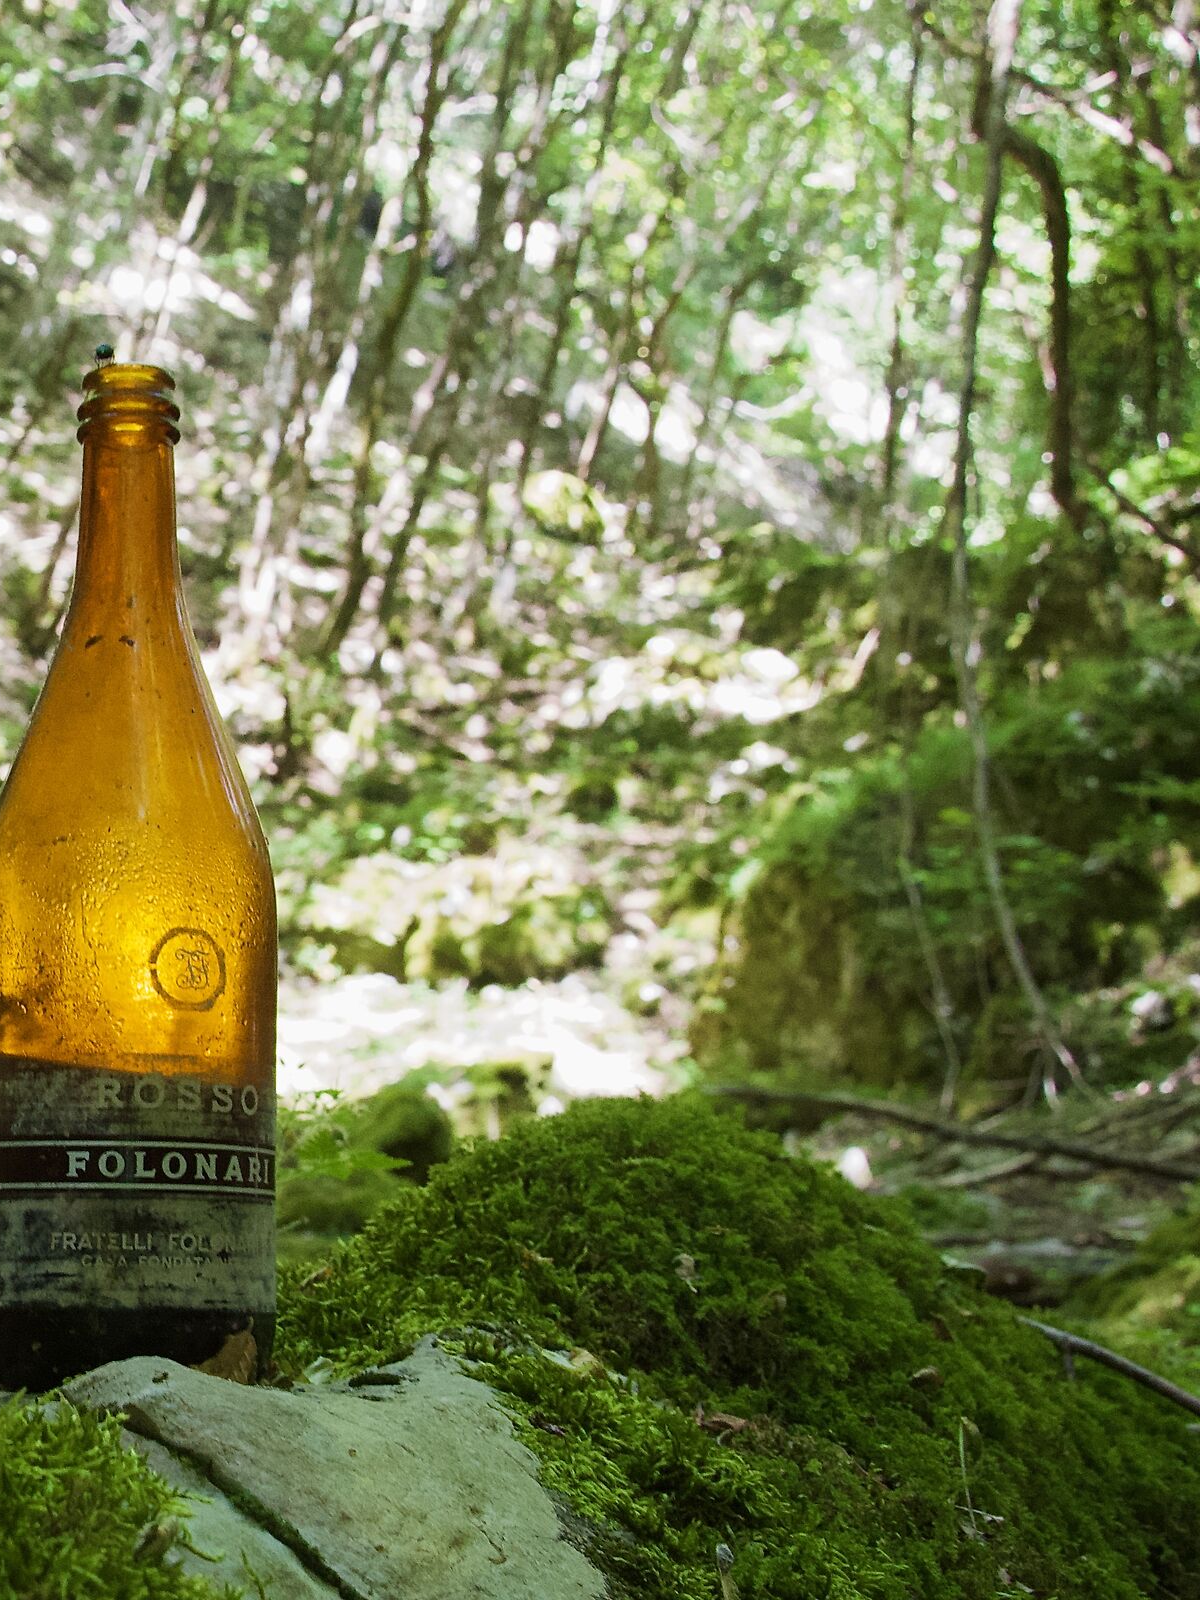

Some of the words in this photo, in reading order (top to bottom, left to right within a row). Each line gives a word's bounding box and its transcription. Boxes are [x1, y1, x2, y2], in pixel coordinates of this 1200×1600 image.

[97, 1076, 259, 1116] ROSSO
[65, 1150, 269, 1185] FOLONARI
[50, 1231, 153, 1251] FRATELLI
